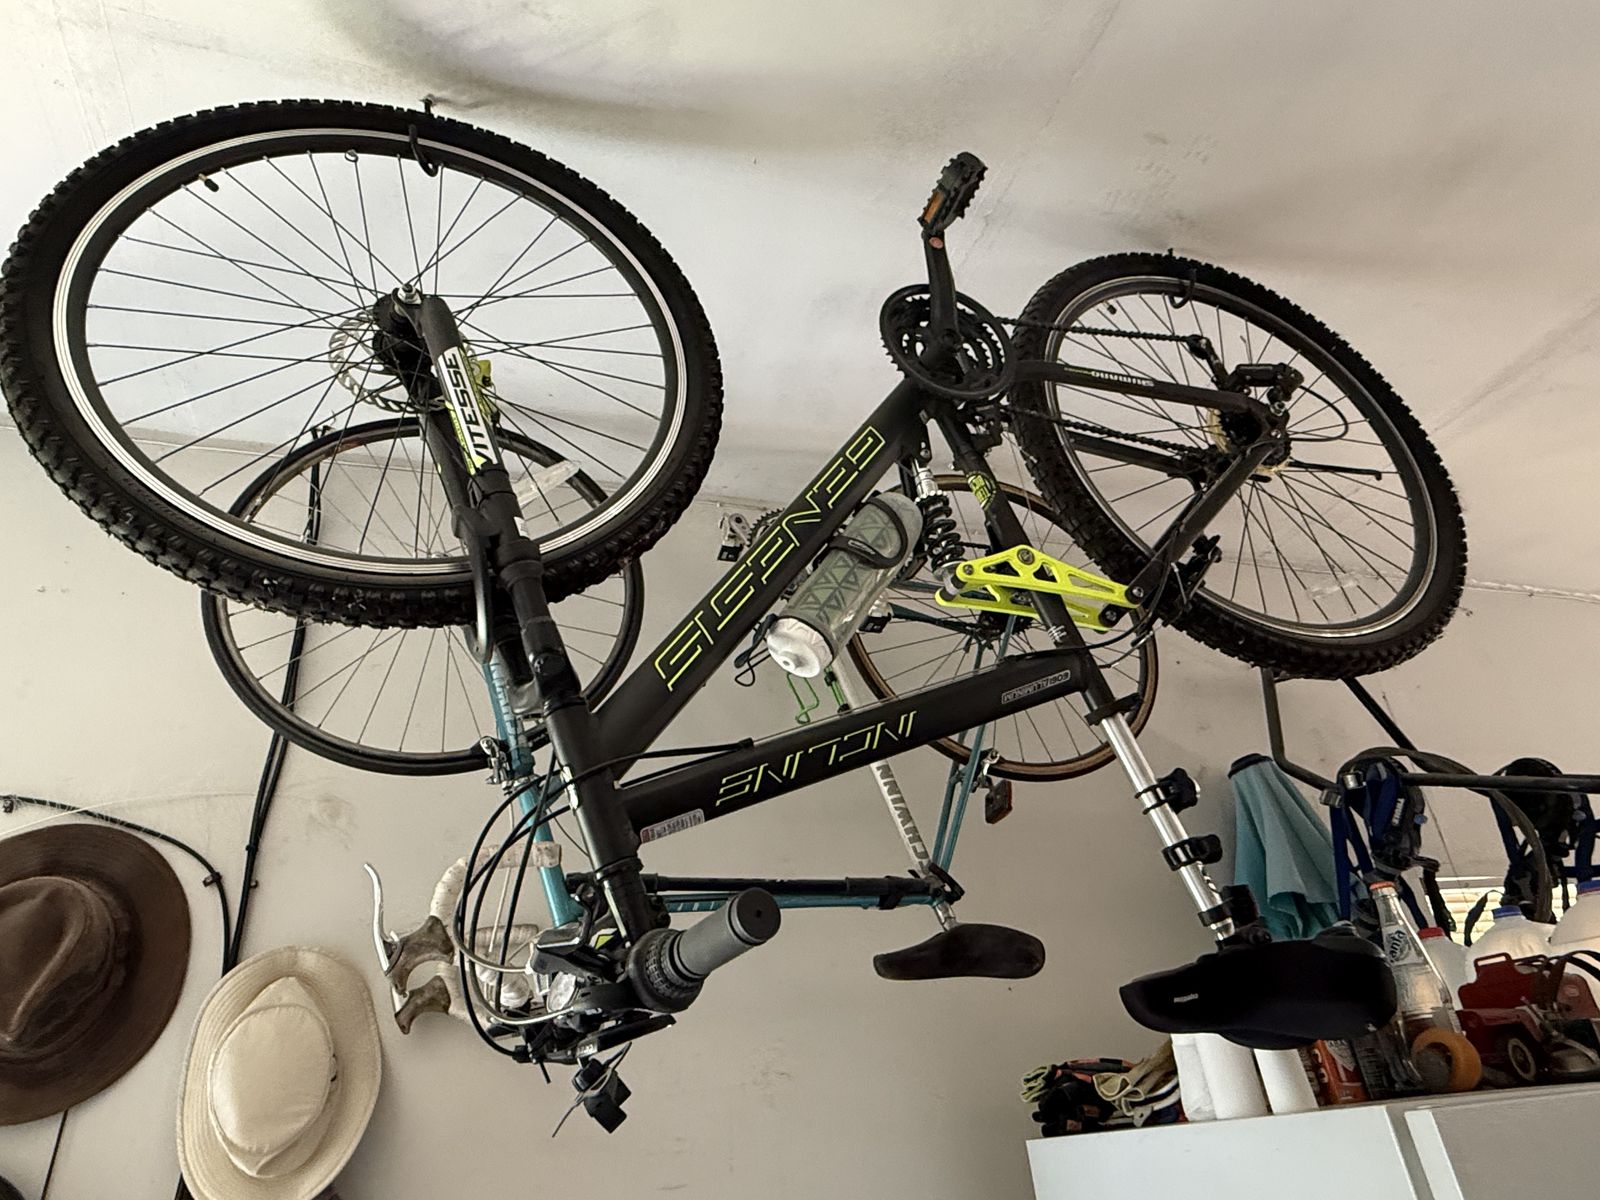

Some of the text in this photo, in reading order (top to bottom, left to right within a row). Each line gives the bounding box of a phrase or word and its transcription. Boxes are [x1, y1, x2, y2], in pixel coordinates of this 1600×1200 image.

[443, 352, 494, 464] VITESSE
[654, 426, 885, 692] GENESIS
[716, 711, 917, 806] INCLINE
[1389, 929, 1406, 963] anta
